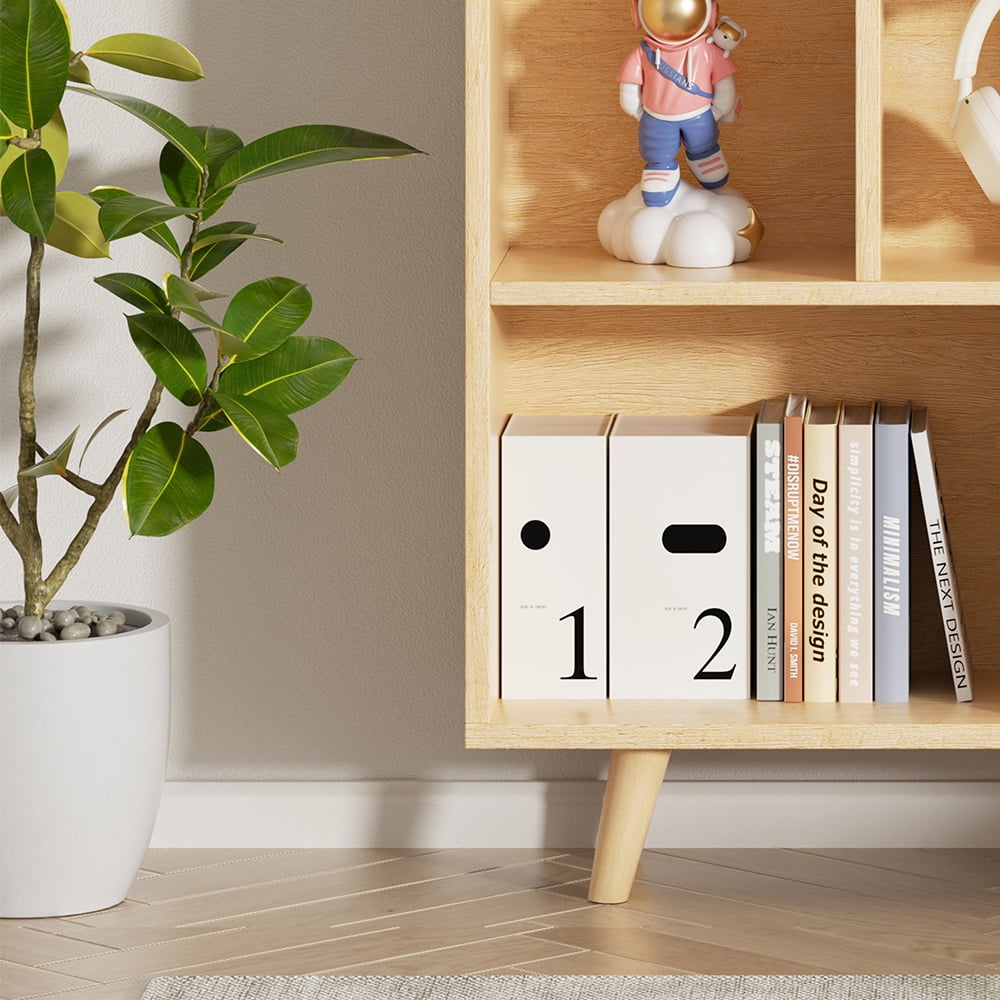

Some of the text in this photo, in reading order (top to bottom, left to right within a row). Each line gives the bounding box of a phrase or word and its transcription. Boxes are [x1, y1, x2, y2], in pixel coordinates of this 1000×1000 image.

[764, 439, 780, 553] STEAM
[787, 454, 800, 561] #DISRUPTMENOW
[809, 478, 829, 663] Day of the design
[847, 441, 862, 687] simplicity is in everything we see
[883, 515, 901, 617] MINIMALISM
[929, 519, 968, 690] THE NEXT DESIGN
[558, 606, 598, 680] 1
[693, 607, 737, 680] 2
[767, 608, 777, 673] IAN HUNT
[789, 622, 798, 646] DAVID
[789, 654, 798, 679] SMITH
